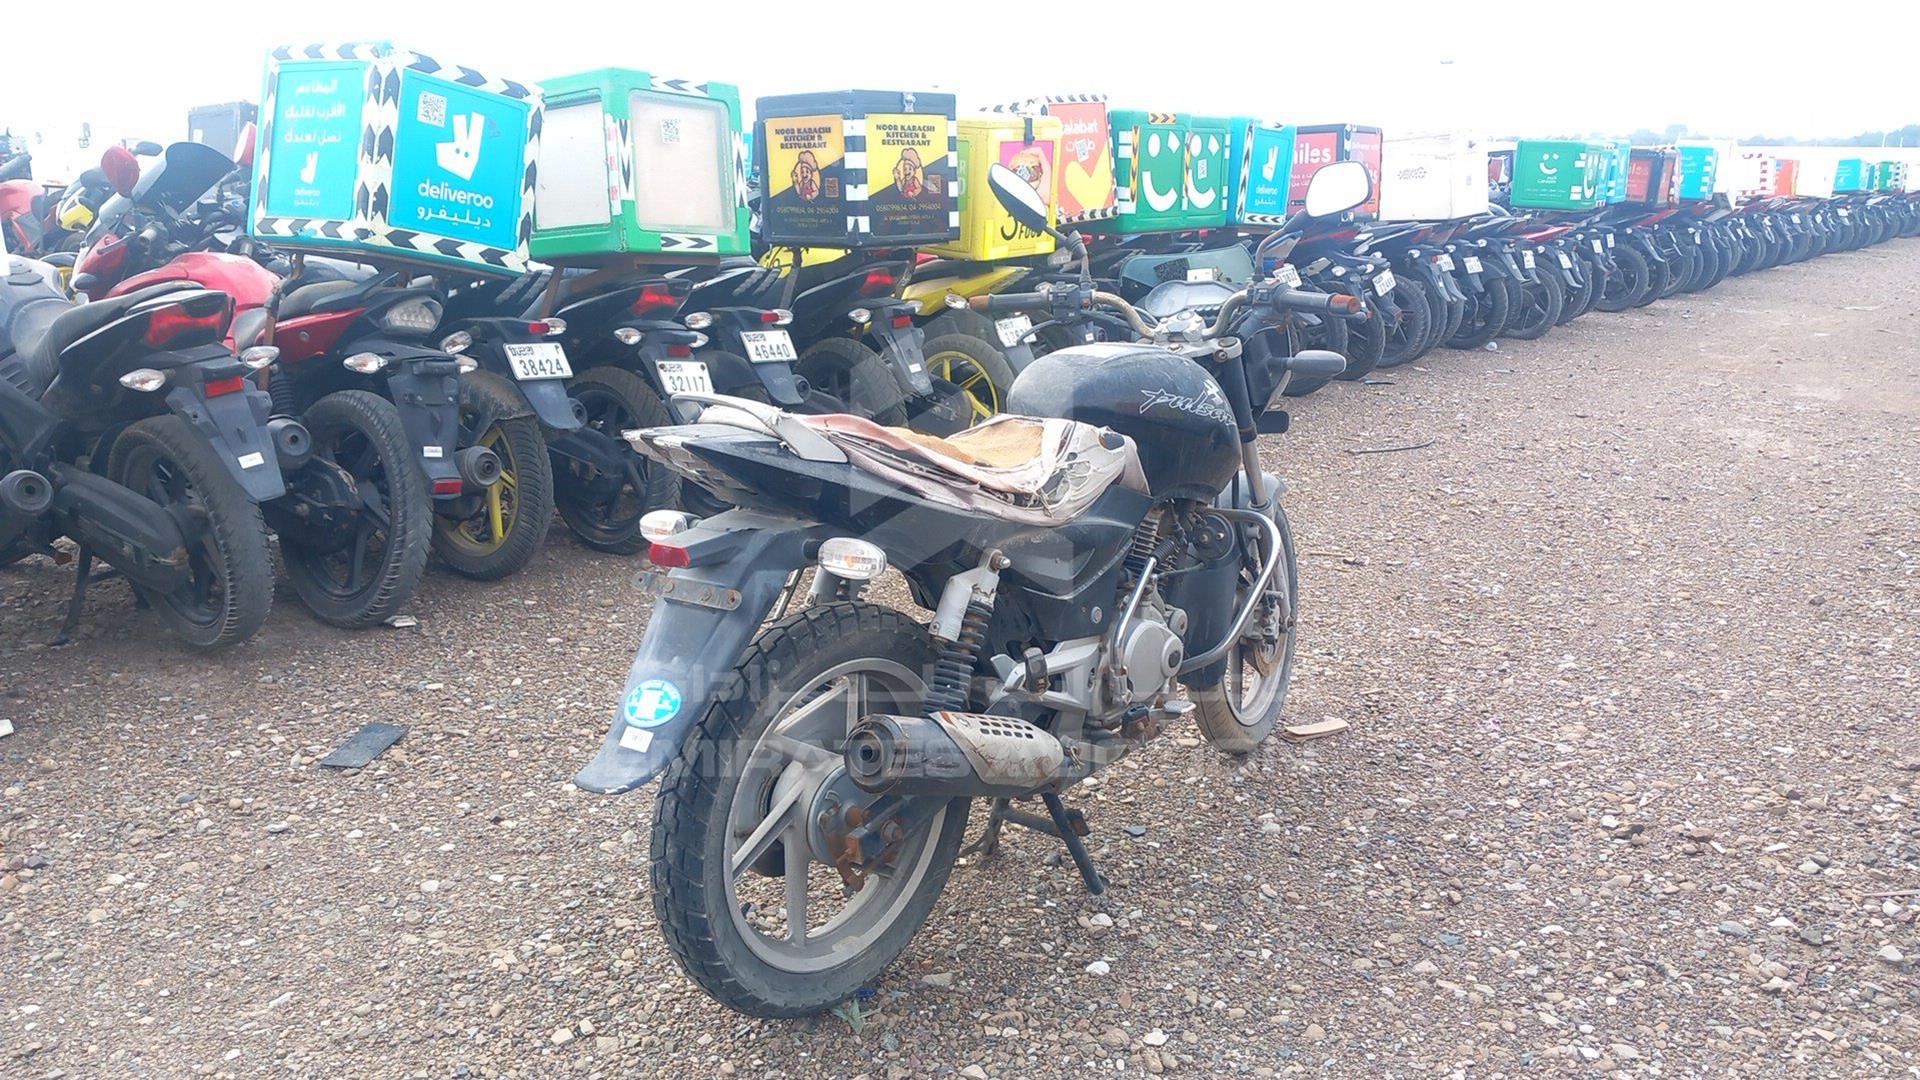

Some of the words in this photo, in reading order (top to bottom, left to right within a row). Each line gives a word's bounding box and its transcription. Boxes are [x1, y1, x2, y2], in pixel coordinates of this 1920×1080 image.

[775, 127, 796, 135] NOOR
[797, 126, 832, 135] KARACHI
[900, 124, 936, 132] KARACHI
[1062, 118, 1099, 135] alabat
[784, 134, 816, 142] KITCHEN
[886, 131, 920, 139] KITCHEN
[417, 178, 494, 209] deliveroo
[417, 205, 492, 229] ديليفرو
[755, 343, 791, 359] 46440
[519, 358, 565, 377] 38424
[669, 375, 705, 392] 32117
